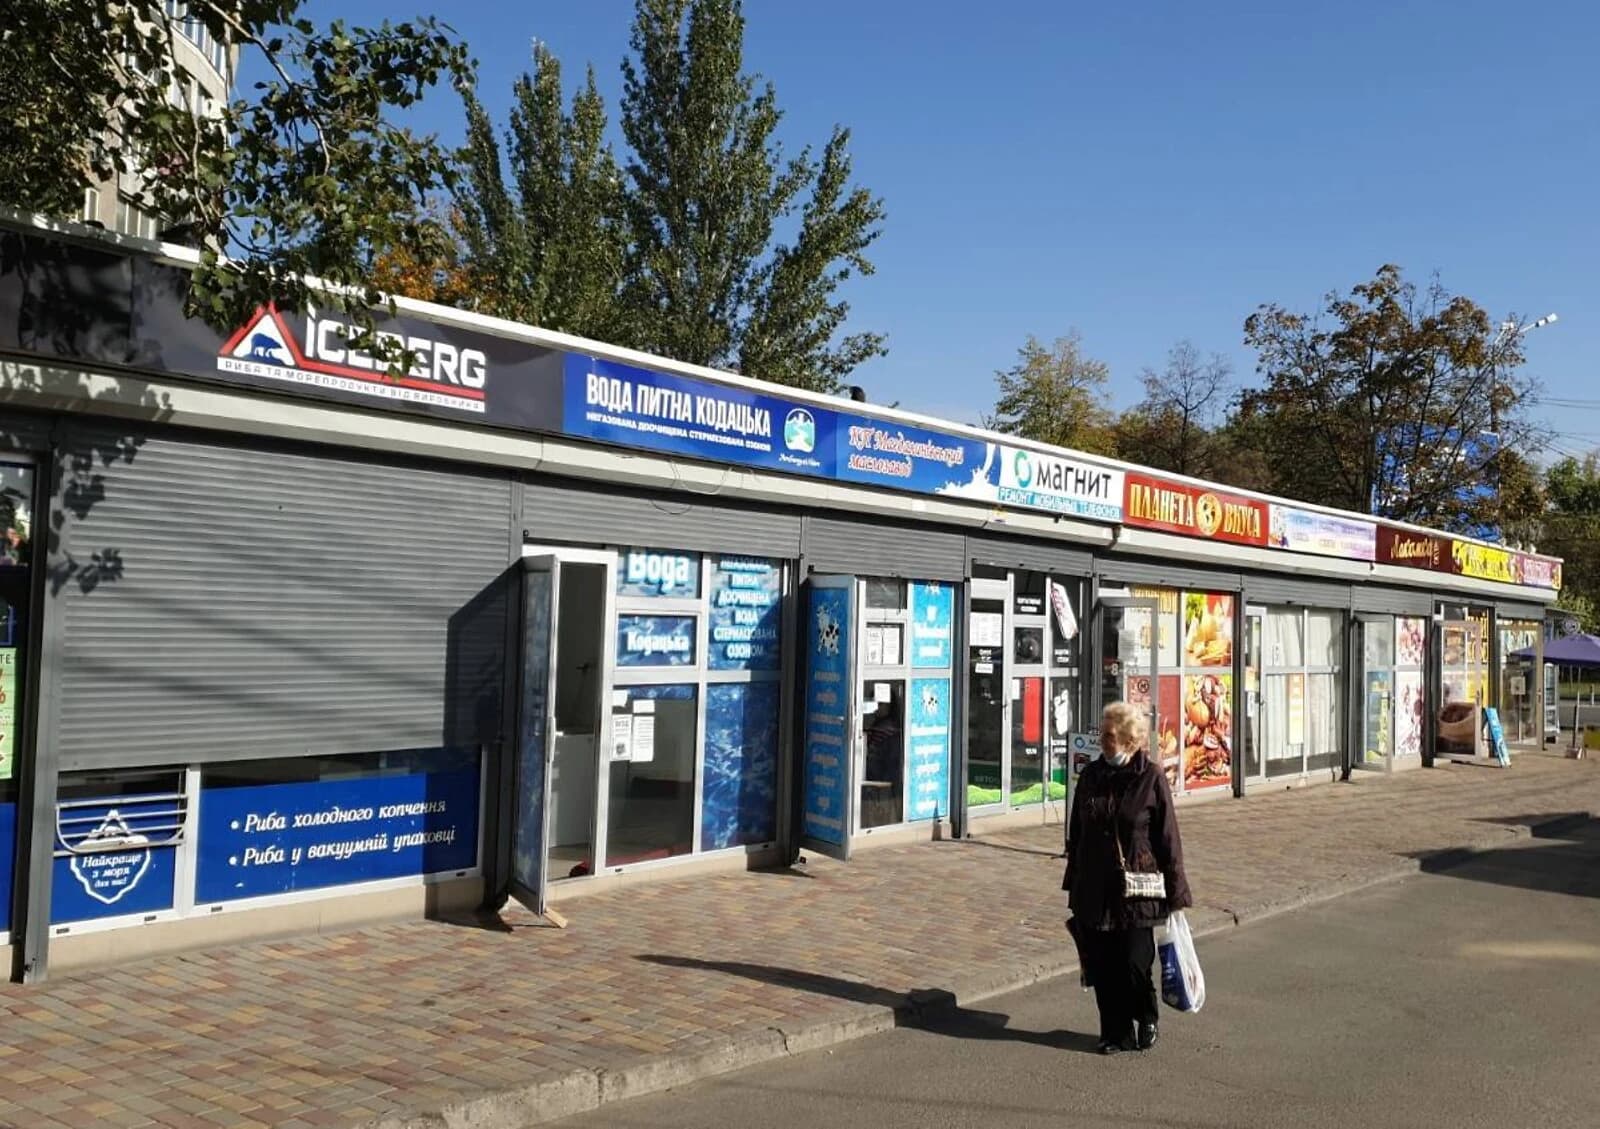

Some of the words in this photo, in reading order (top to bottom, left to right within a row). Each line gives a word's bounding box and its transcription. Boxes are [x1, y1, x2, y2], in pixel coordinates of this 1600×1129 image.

[224, 360, 262, 375] РИБА
[267, 367, 282, 377] ТА
[586, 372, 633, 413] ВОДА
[636, 383, 693, 424] ПИТНА
[696, 395, 772, 438] КОДАЦЬКА
[1129, 483, 1195, 528] ПЛАНЕТА
[1223, 502, 1262, 538] ВКУСА
[244, 811, 286, 832] Риба
[292, 806, 374, 828] холодного
[379, 800, 446, 819] копчення
[81, 854, 143, 868] Найкраще
[242, 845, 285, 867] Риба
[290, 847, 302, 866] у
[307, 832, 388, 860] вакуумній
[392, 825, 456, 853] упаковці
[102, 867, 130, 879] моря
